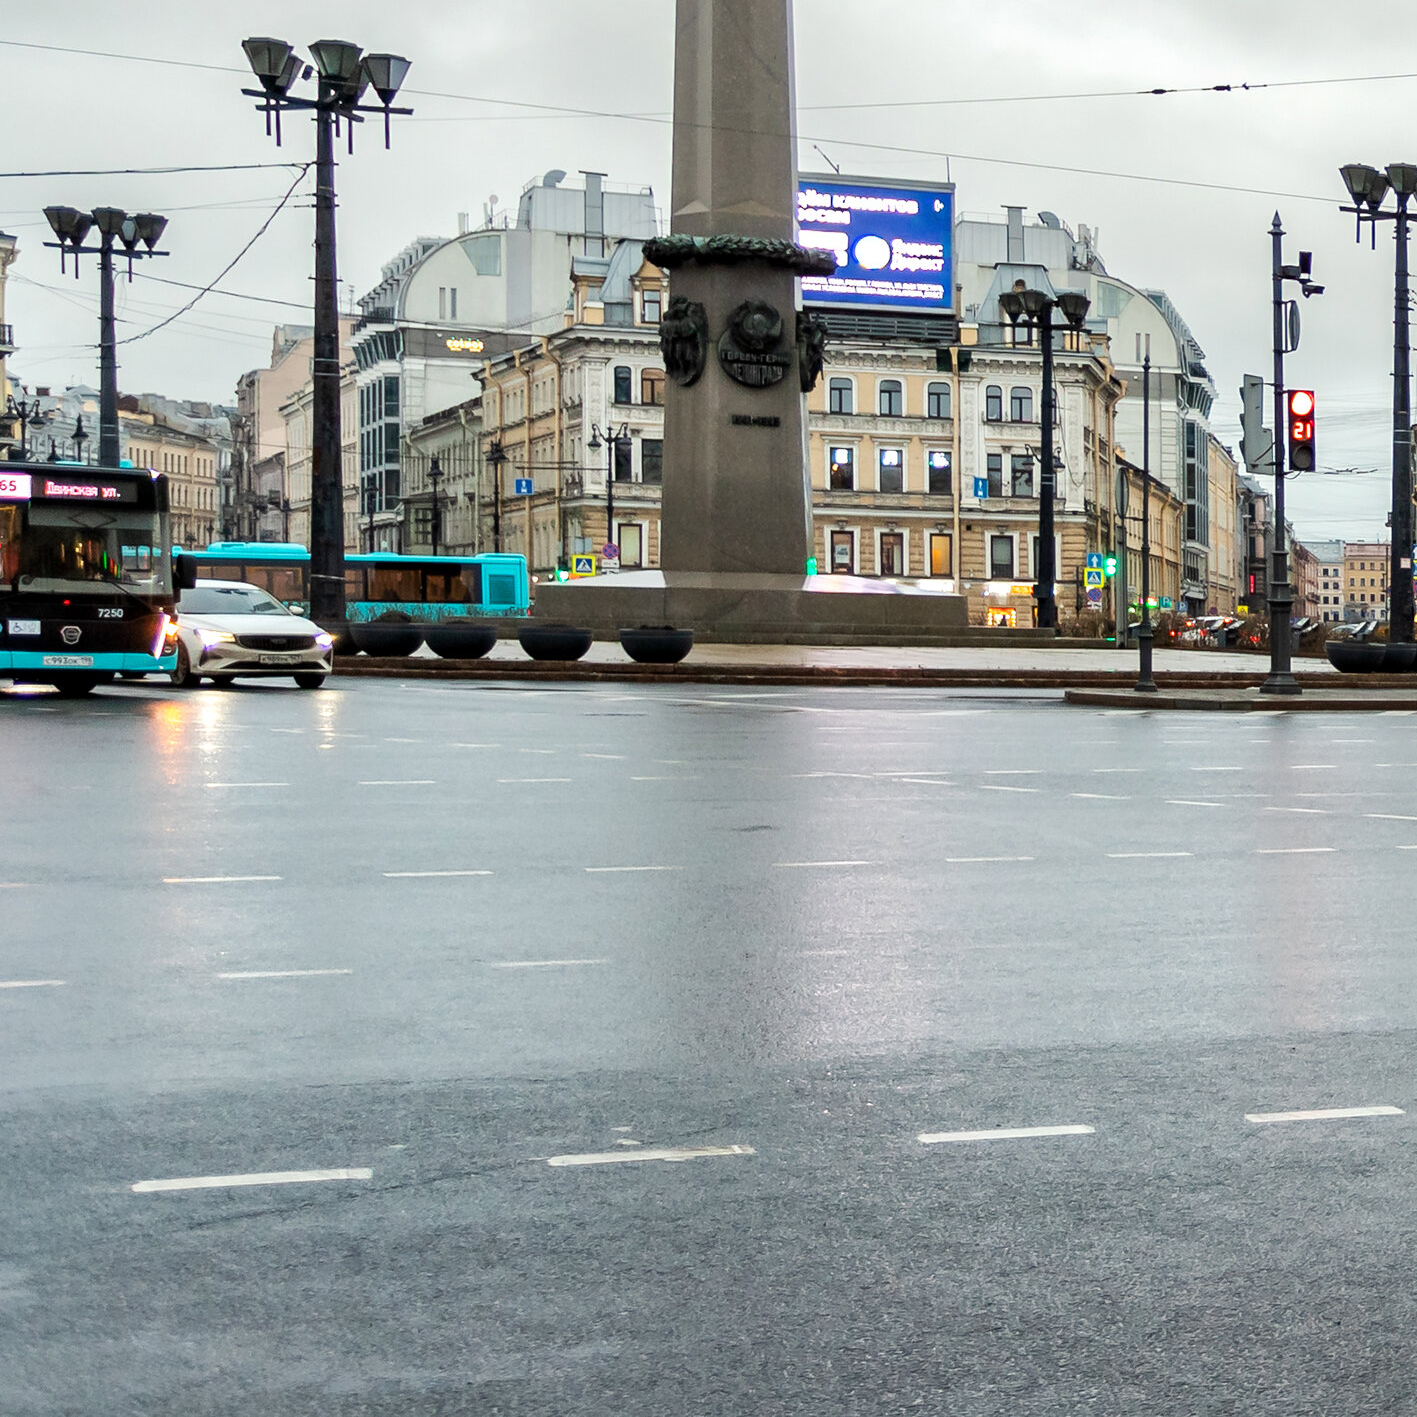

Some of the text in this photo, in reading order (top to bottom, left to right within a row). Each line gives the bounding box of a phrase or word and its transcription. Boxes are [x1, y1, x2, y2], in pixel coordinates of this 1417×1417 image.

[1293, 421, 1312, 439] 21
[45, 481, 121, 498] Двинская ул.
[98, 608, 124, 618] 7250
